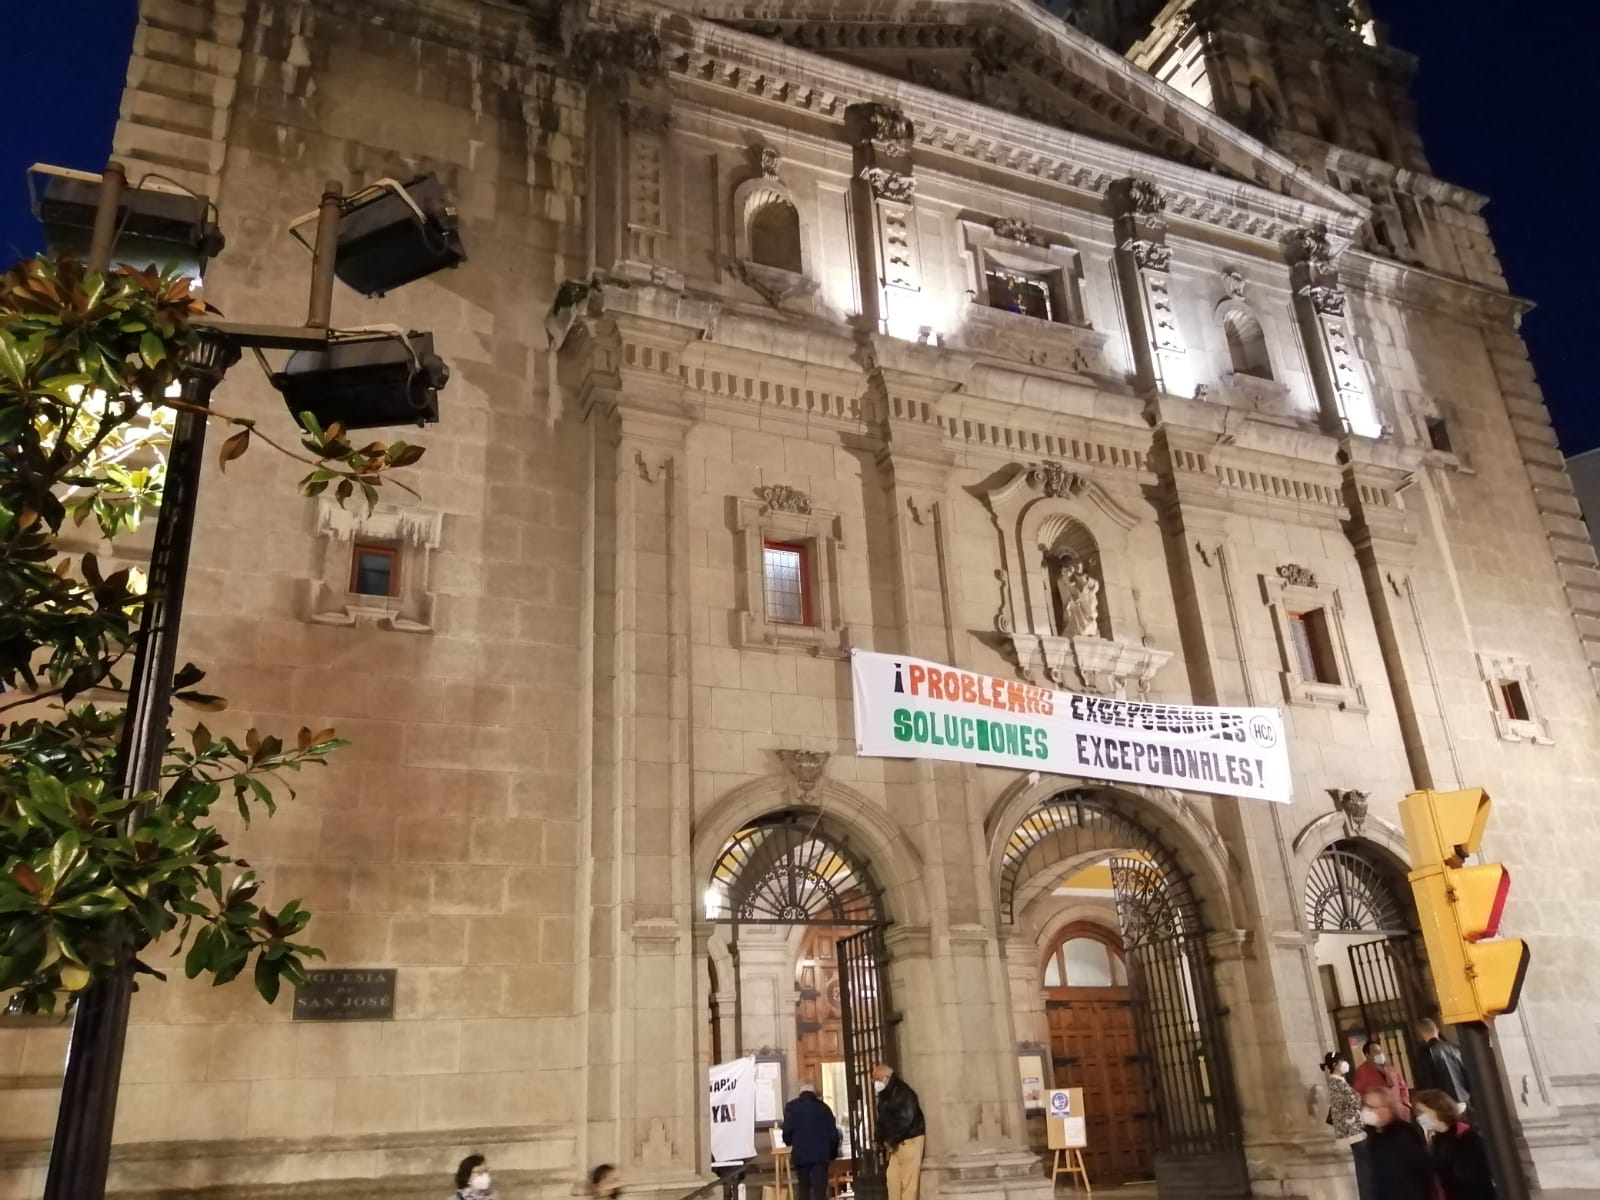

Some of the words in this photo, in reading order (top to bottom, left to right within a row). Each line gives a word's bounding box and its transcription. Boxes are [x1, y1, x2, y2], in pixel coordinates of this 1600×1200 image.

[1252, 721, 1275, 744] HCC
[893, 708, 1049, 760] SOLUCIONES
[1075, 733, 1265, 789] EXCEPCIONALES!
[297, 997, 336, 1008] SAN
[711, 1103, 737, 1124] YA!
